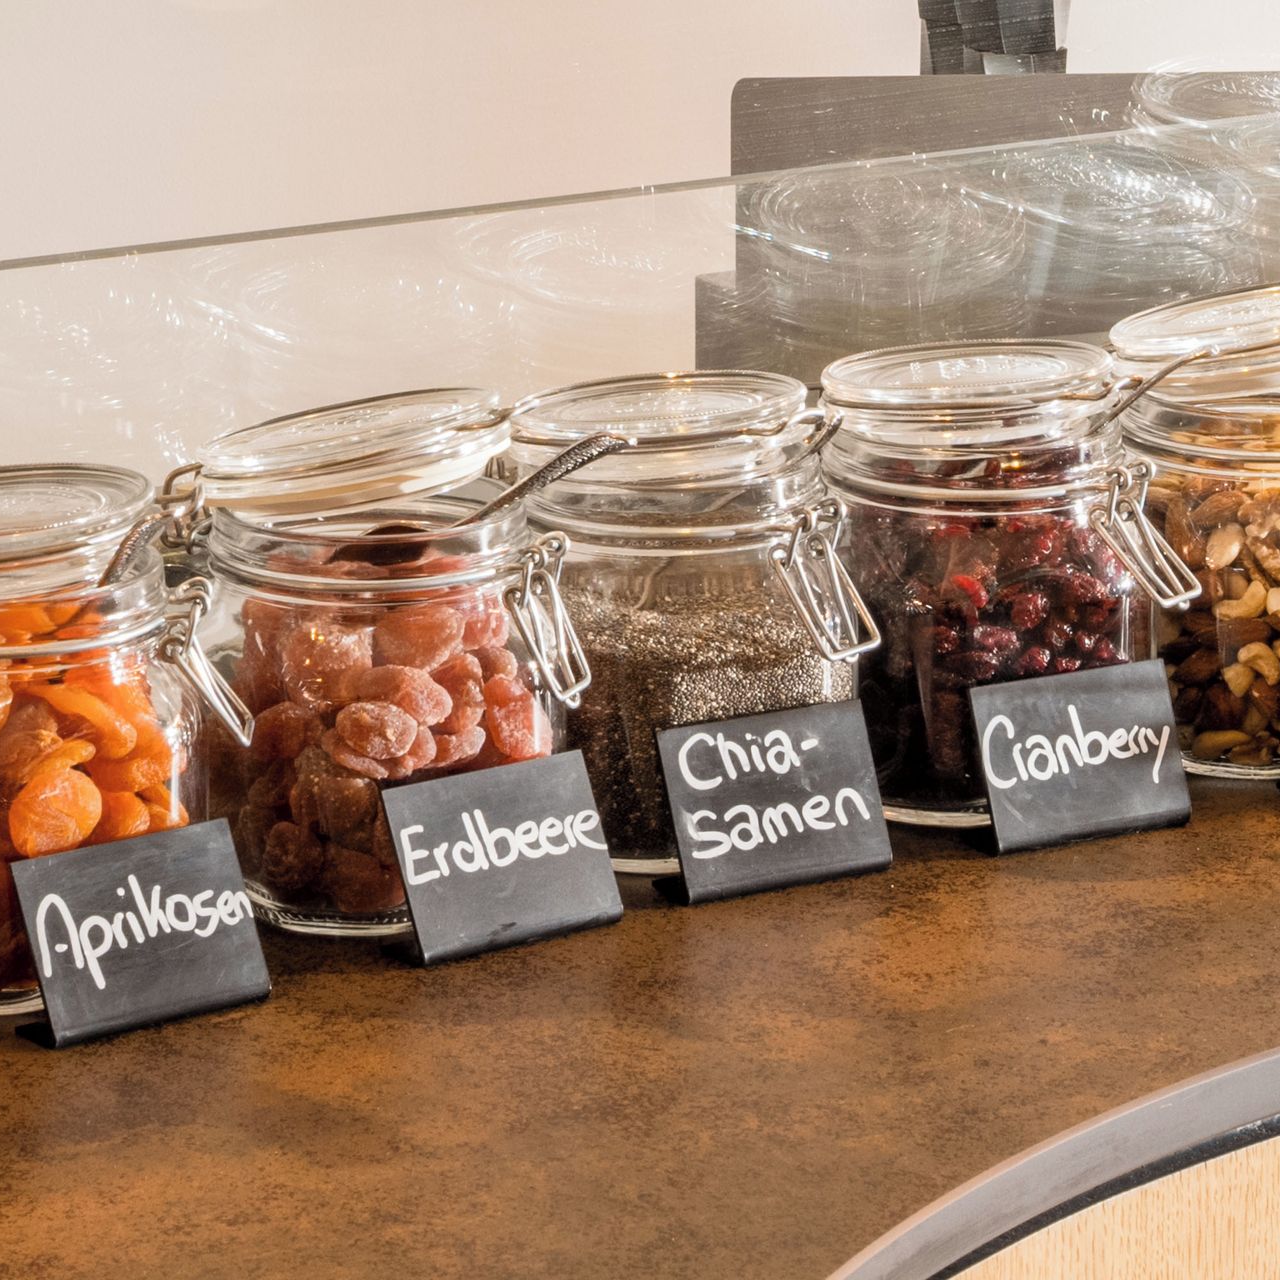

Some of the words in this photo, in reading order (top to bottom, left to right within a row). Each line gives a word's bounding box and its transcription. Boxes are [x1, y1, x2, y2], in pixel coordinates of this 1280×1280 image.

[678, 730, 818, 790] Chia-
[983, 704, 1170, 789] Cranberry
[400, 809, 608, 885] Erdbeere
[36, 874, 254, 989] Aprikosen
